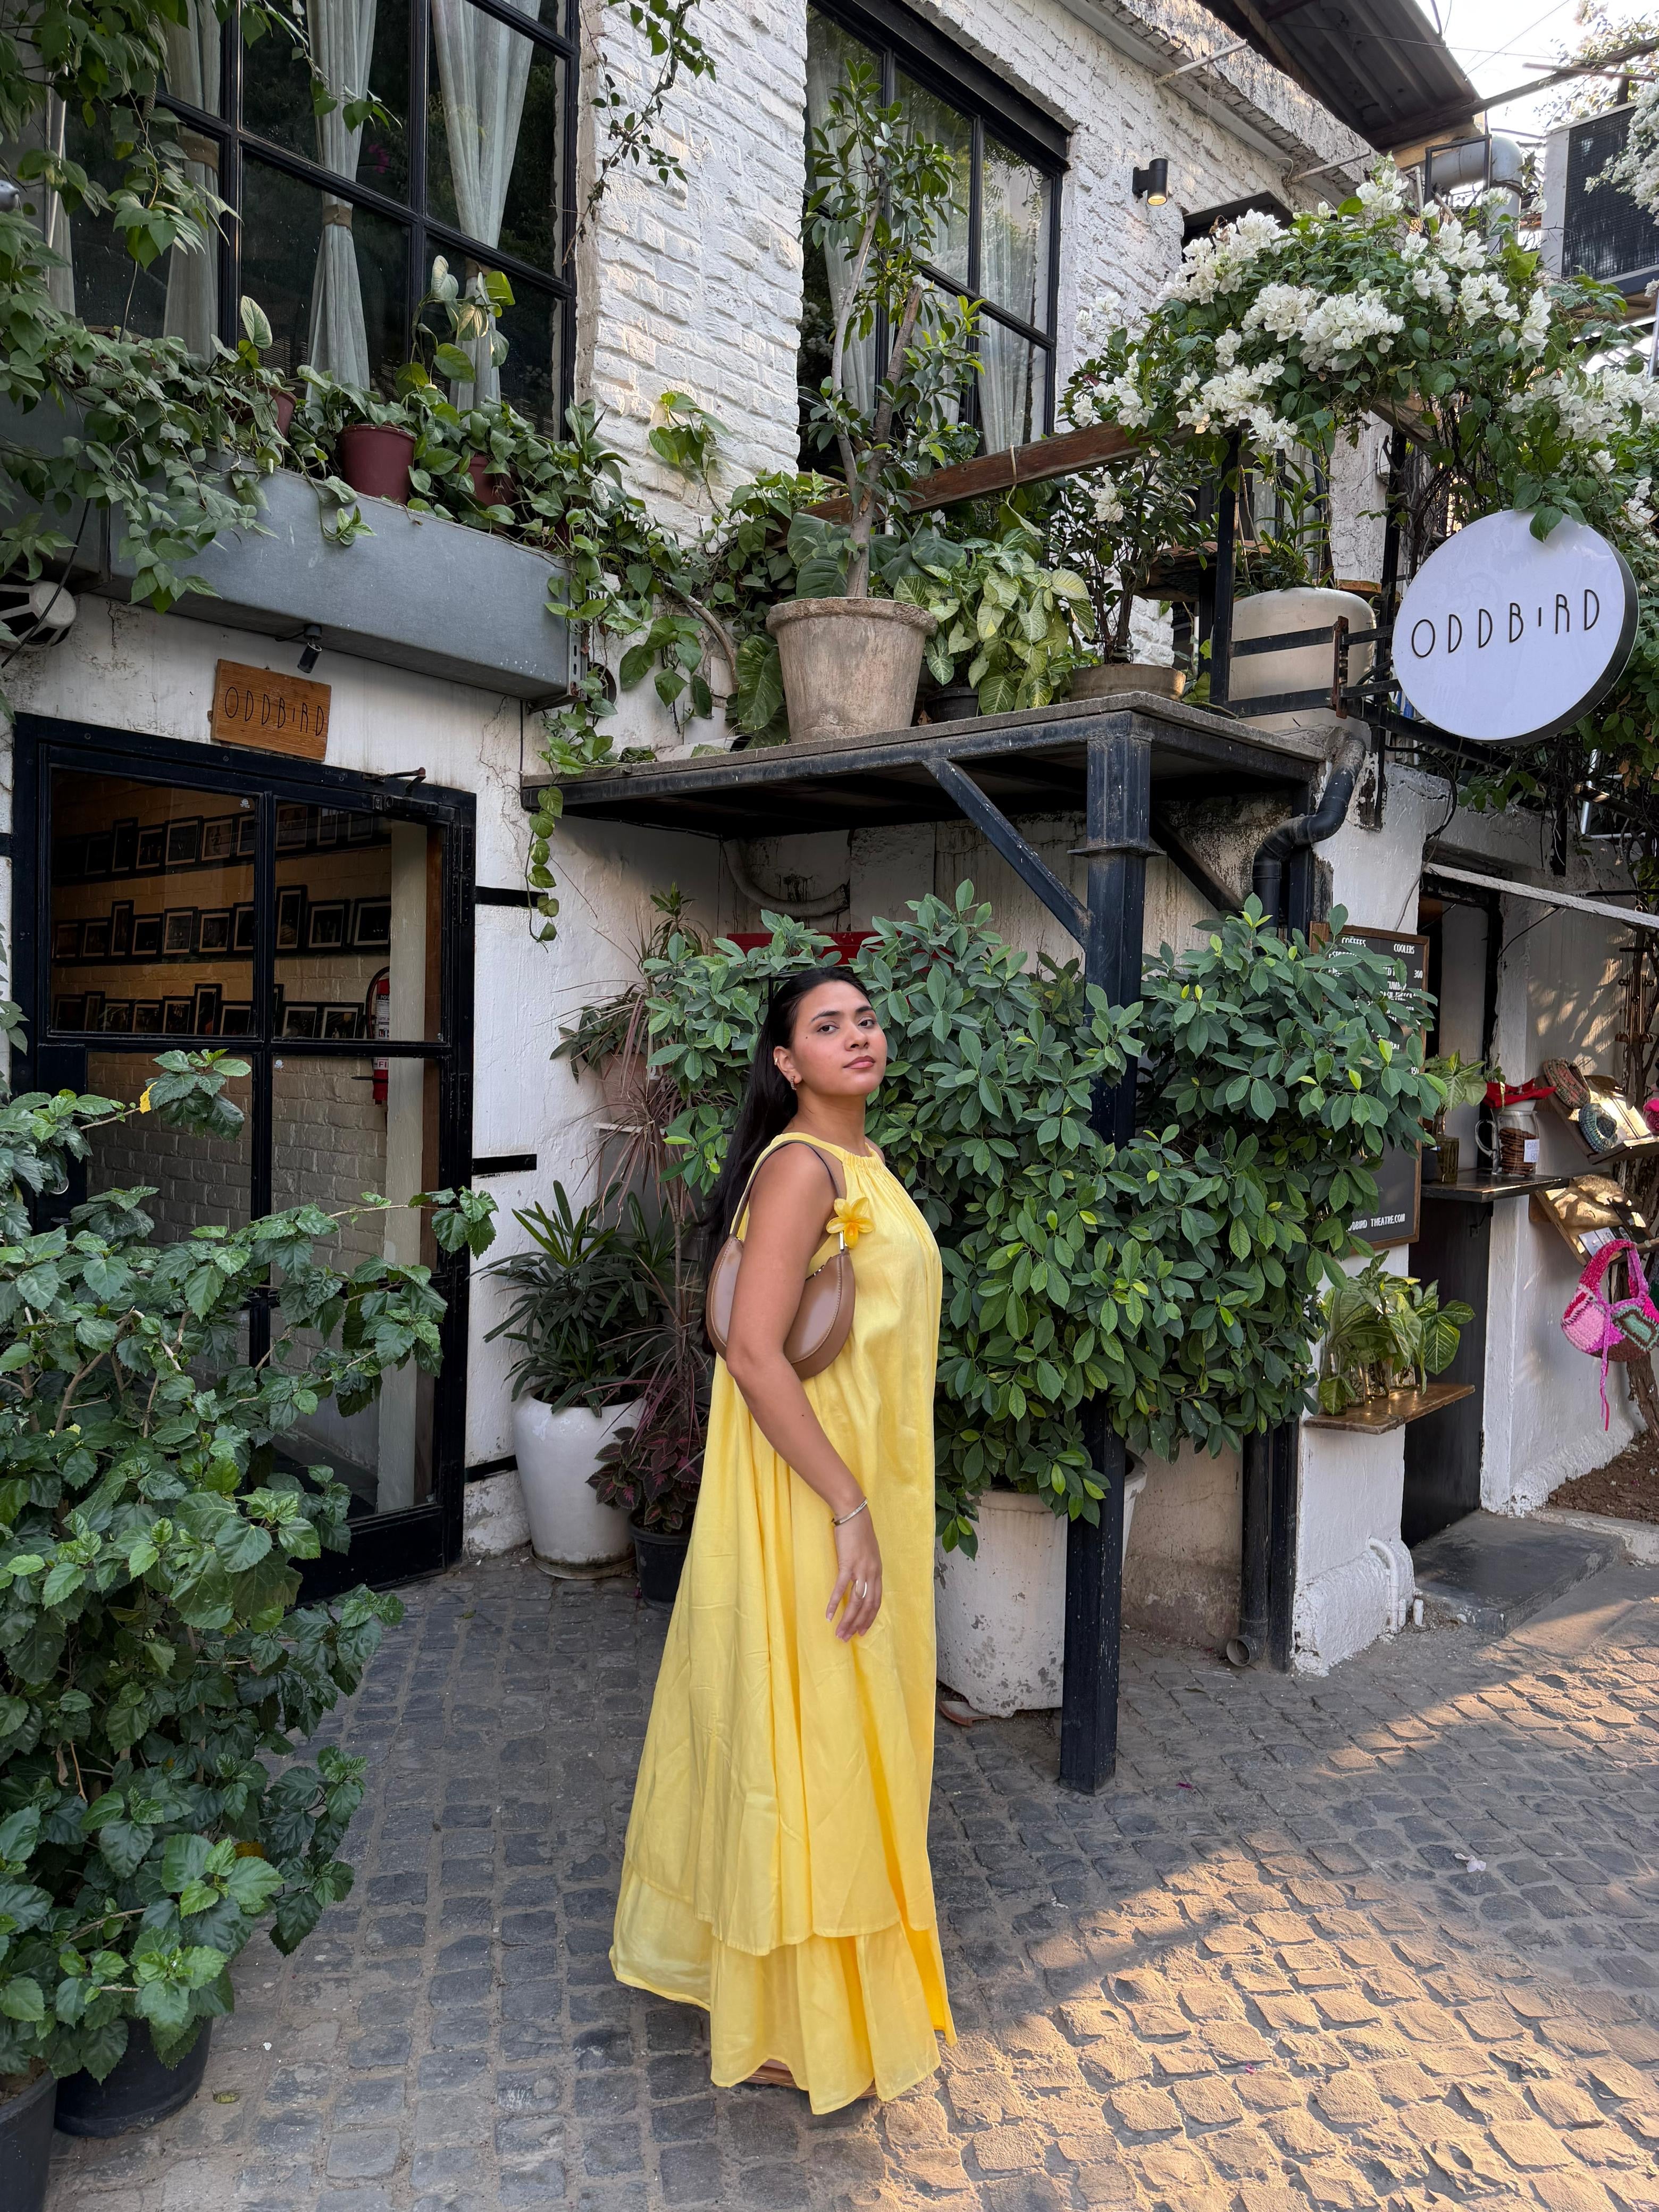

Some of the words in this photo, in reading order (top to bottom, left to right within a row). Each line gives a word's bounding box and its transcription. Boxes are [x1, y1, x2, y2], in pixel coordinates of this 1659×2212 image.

[1411, 589, 1599, 658] ODDBIRD
[224, 686, 324, 736] ODDBIRD
[1394, 943, 1415, 954] COOLERS
[1413, 970, 1423, 979] 300
